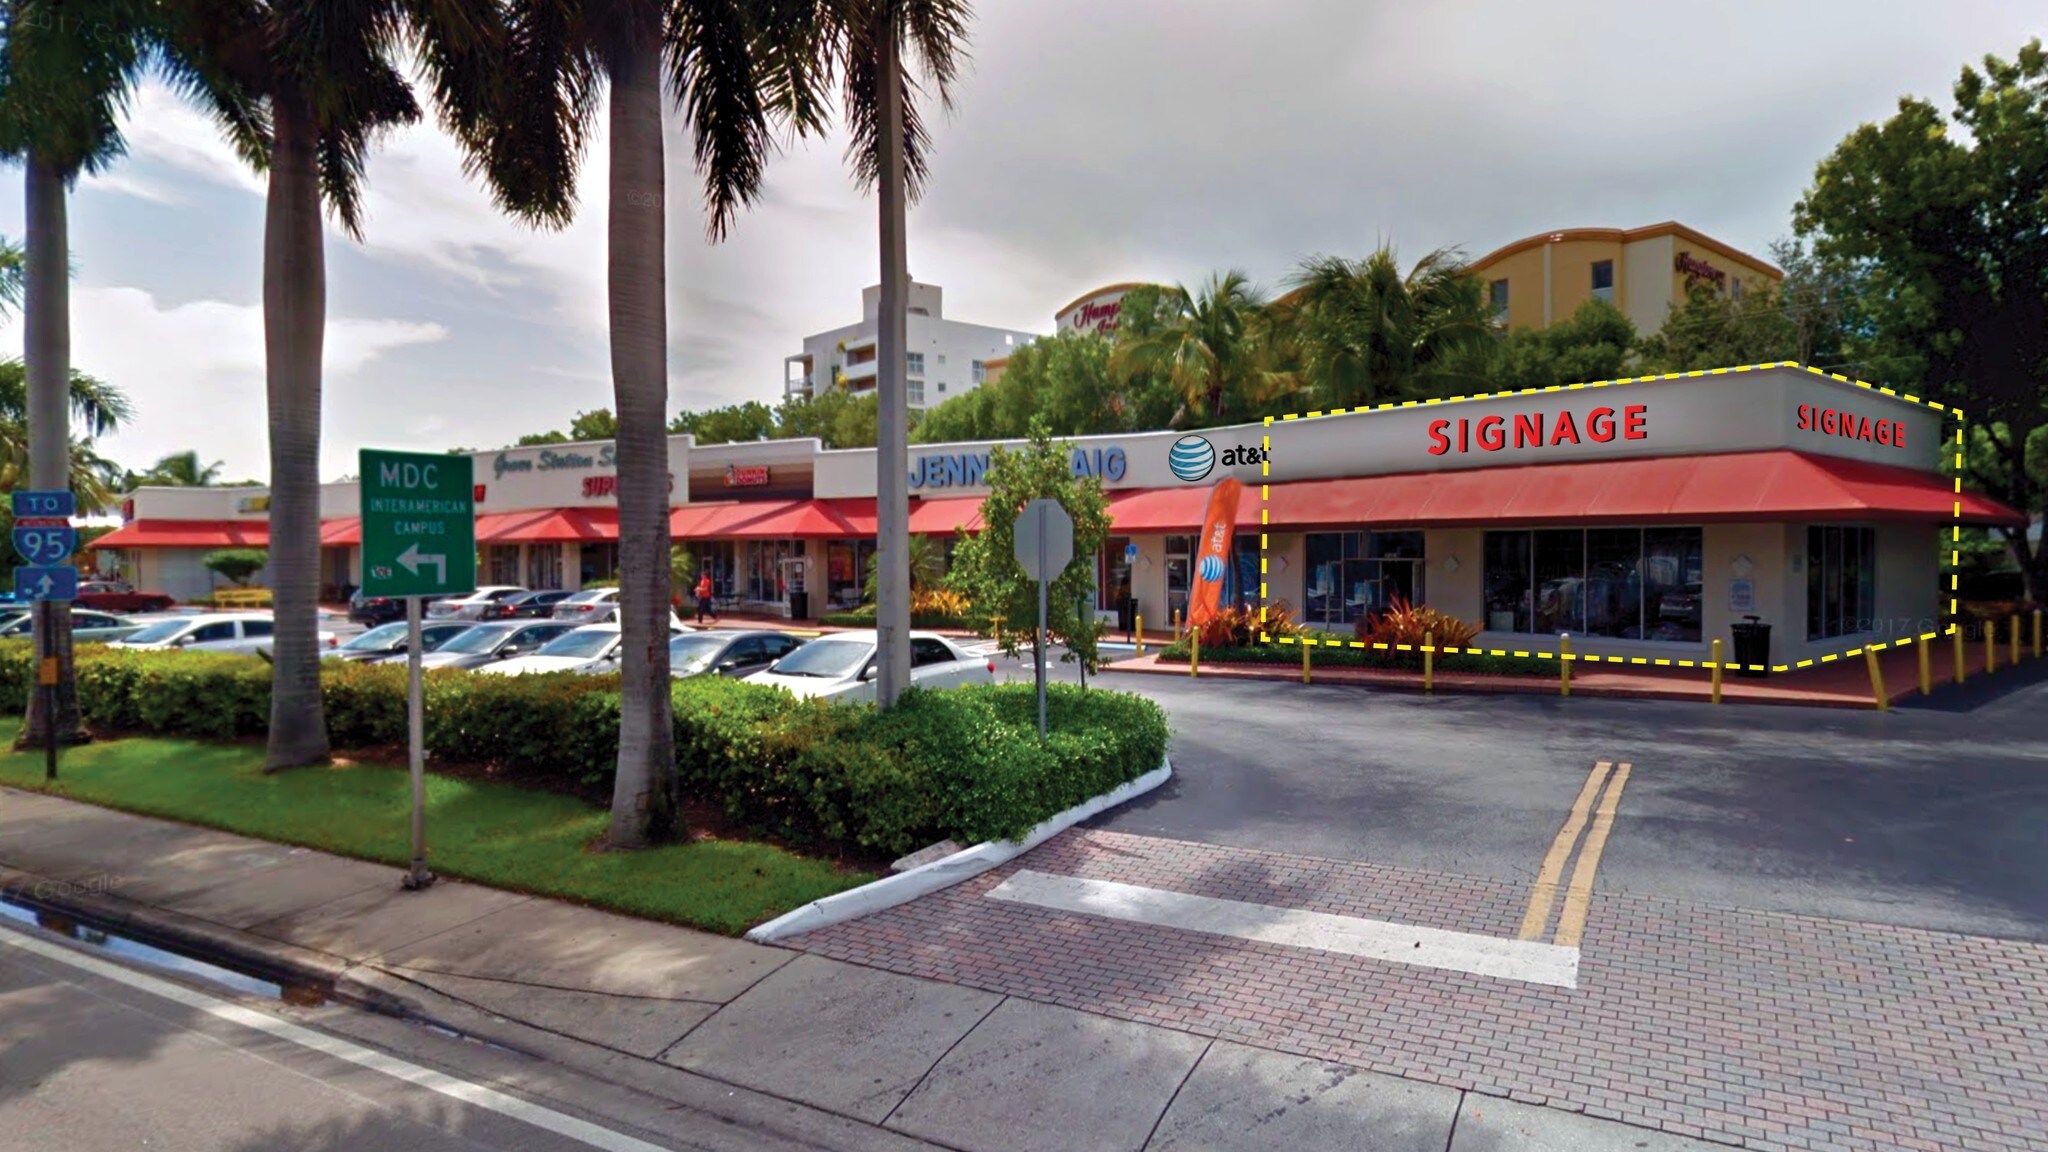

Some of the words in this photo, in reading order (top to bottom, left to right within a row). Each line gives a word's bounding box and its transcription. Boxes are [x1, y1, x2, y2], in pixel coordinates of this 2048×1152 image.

[1221, 444, 1271, 466] at&t
[380, 461, 438, 489] MDC
[909, 452, 1009, 489] JENN
[27, 497, 58, 511] TO
[370, 498, 467, 513] INTERAMERICAN
[394, 521, 445, 535] CAMPUS
[1211, 522, 1227, 552] at&t
[24, 532, 64, 558] 95
